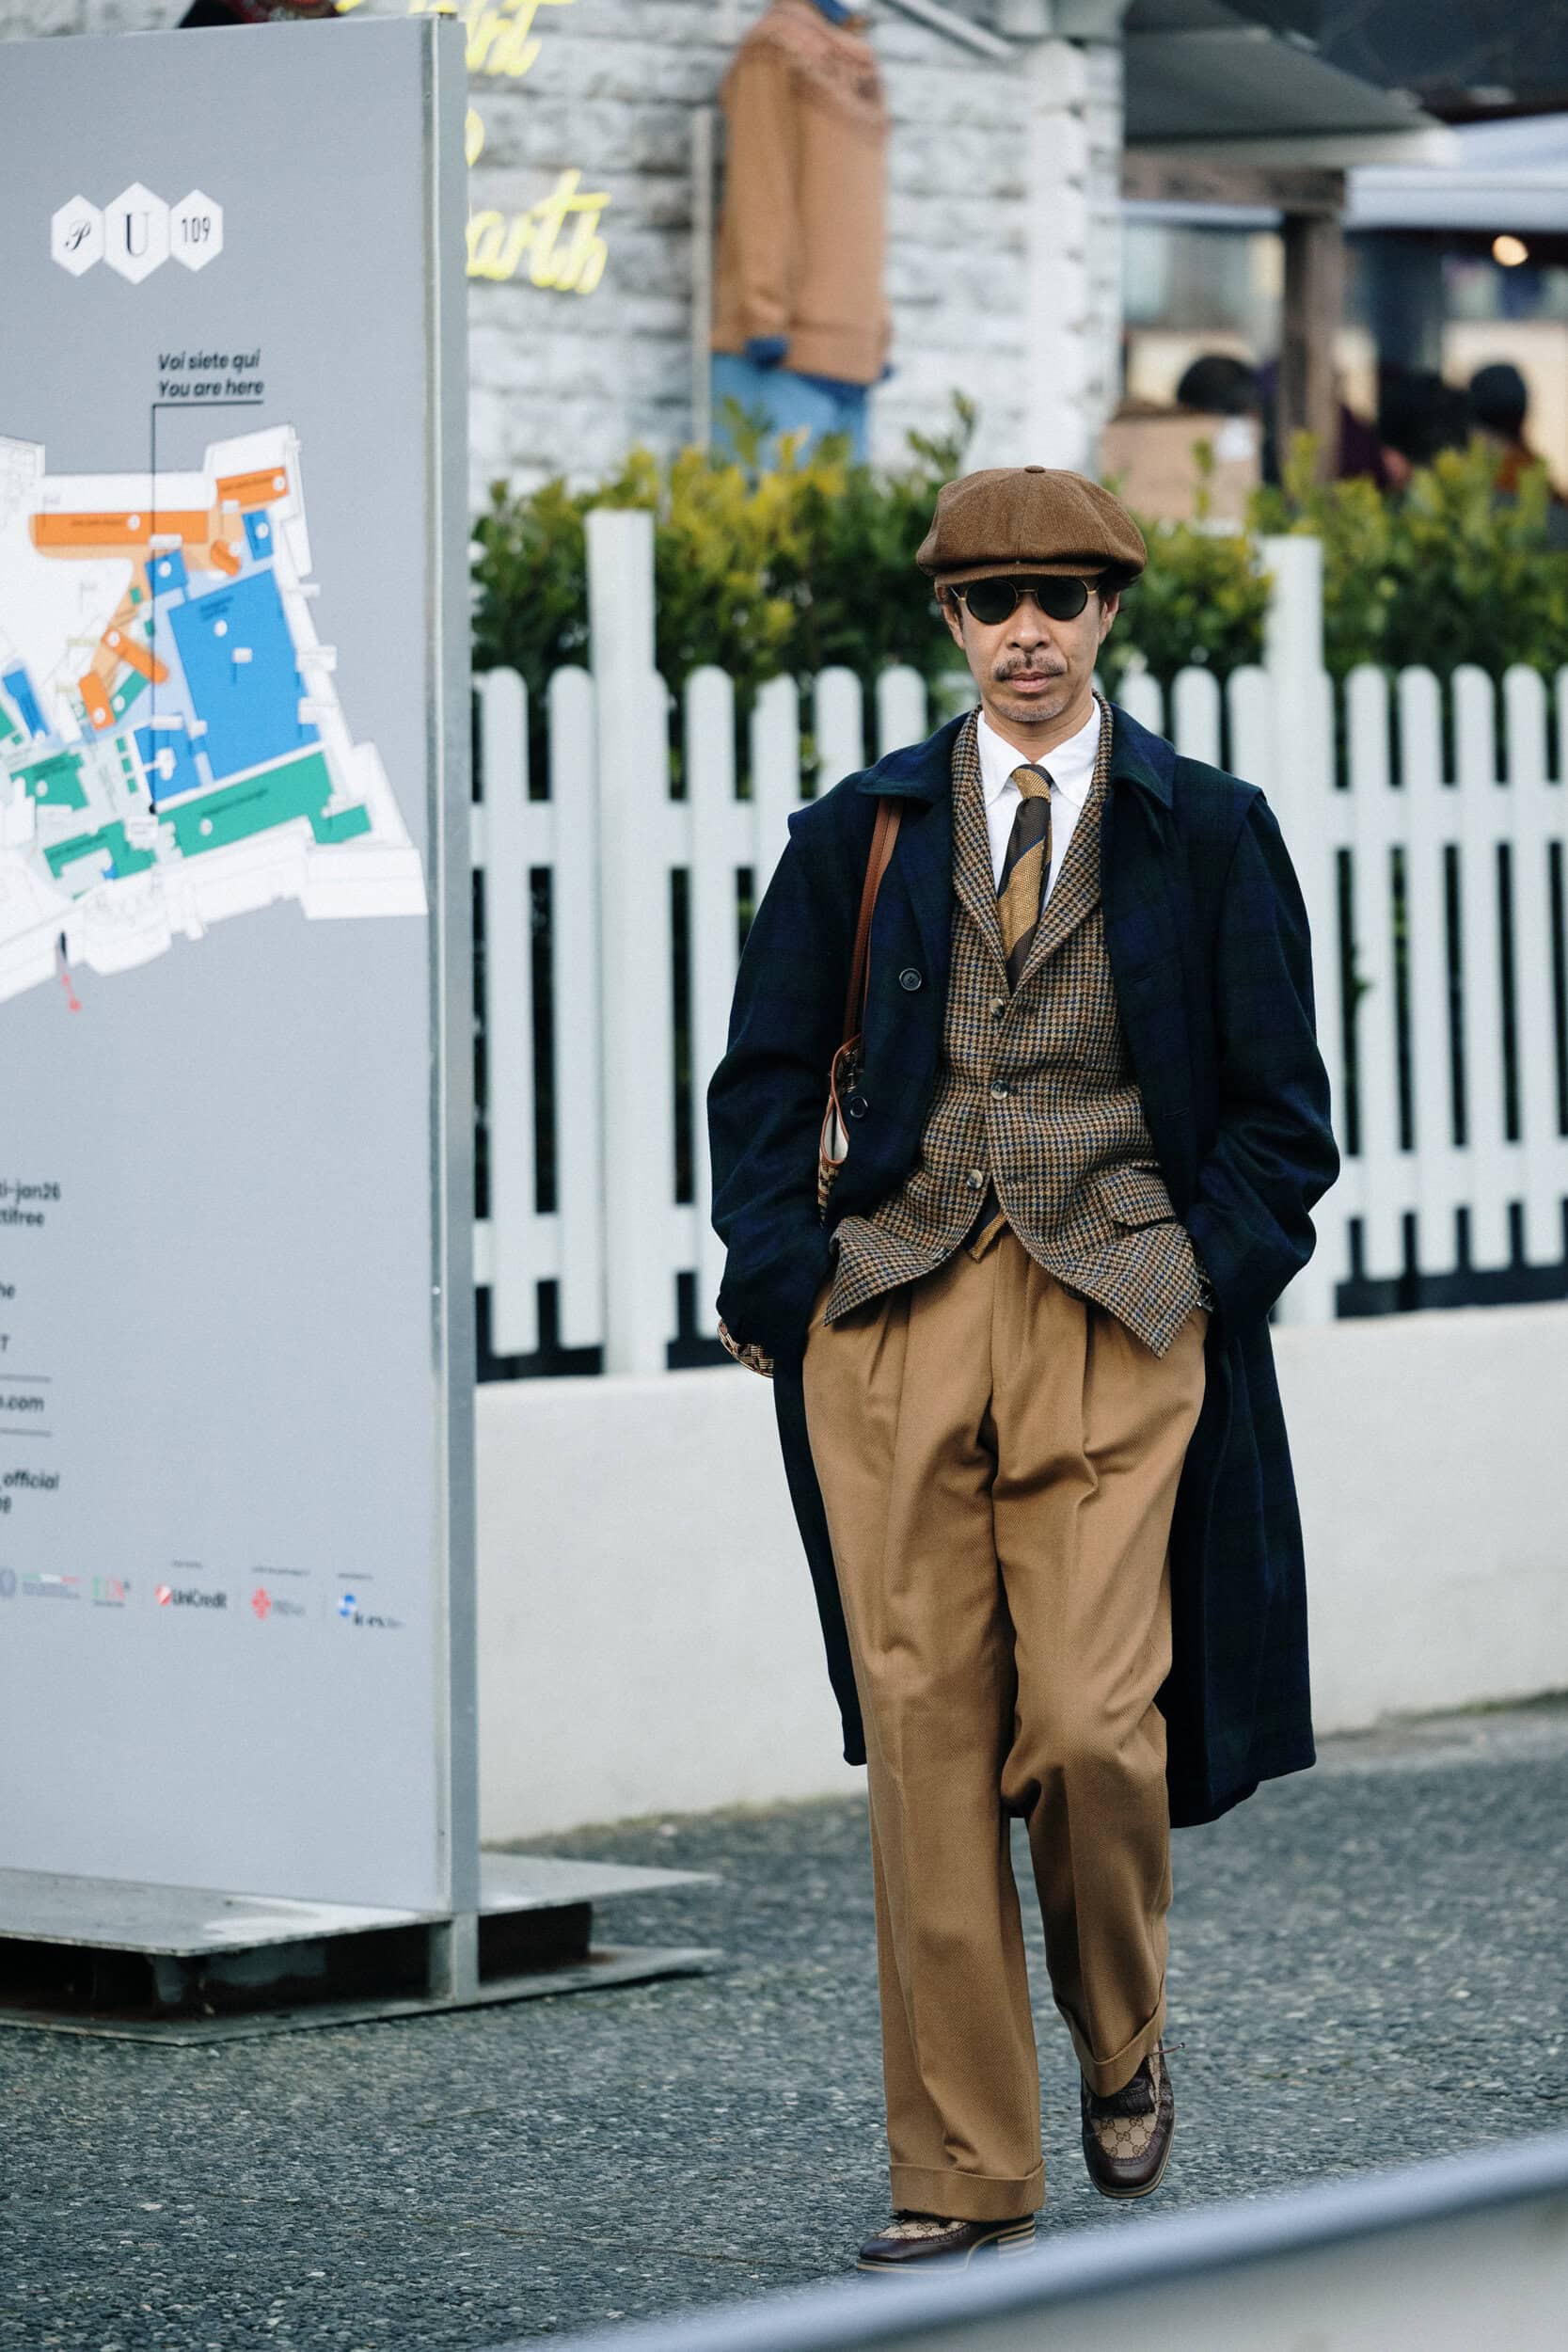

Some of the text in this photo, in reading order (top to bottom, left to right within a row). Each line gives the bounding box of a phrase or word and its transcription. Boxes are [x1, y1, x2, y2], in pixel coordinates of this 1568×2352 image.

[64, 211, 211, 258] P U 109
[158, 348, 261, 374] Voi siete qui
[159, 378, 264, 397] You are here
[4, 1470, 60, 1491] official
